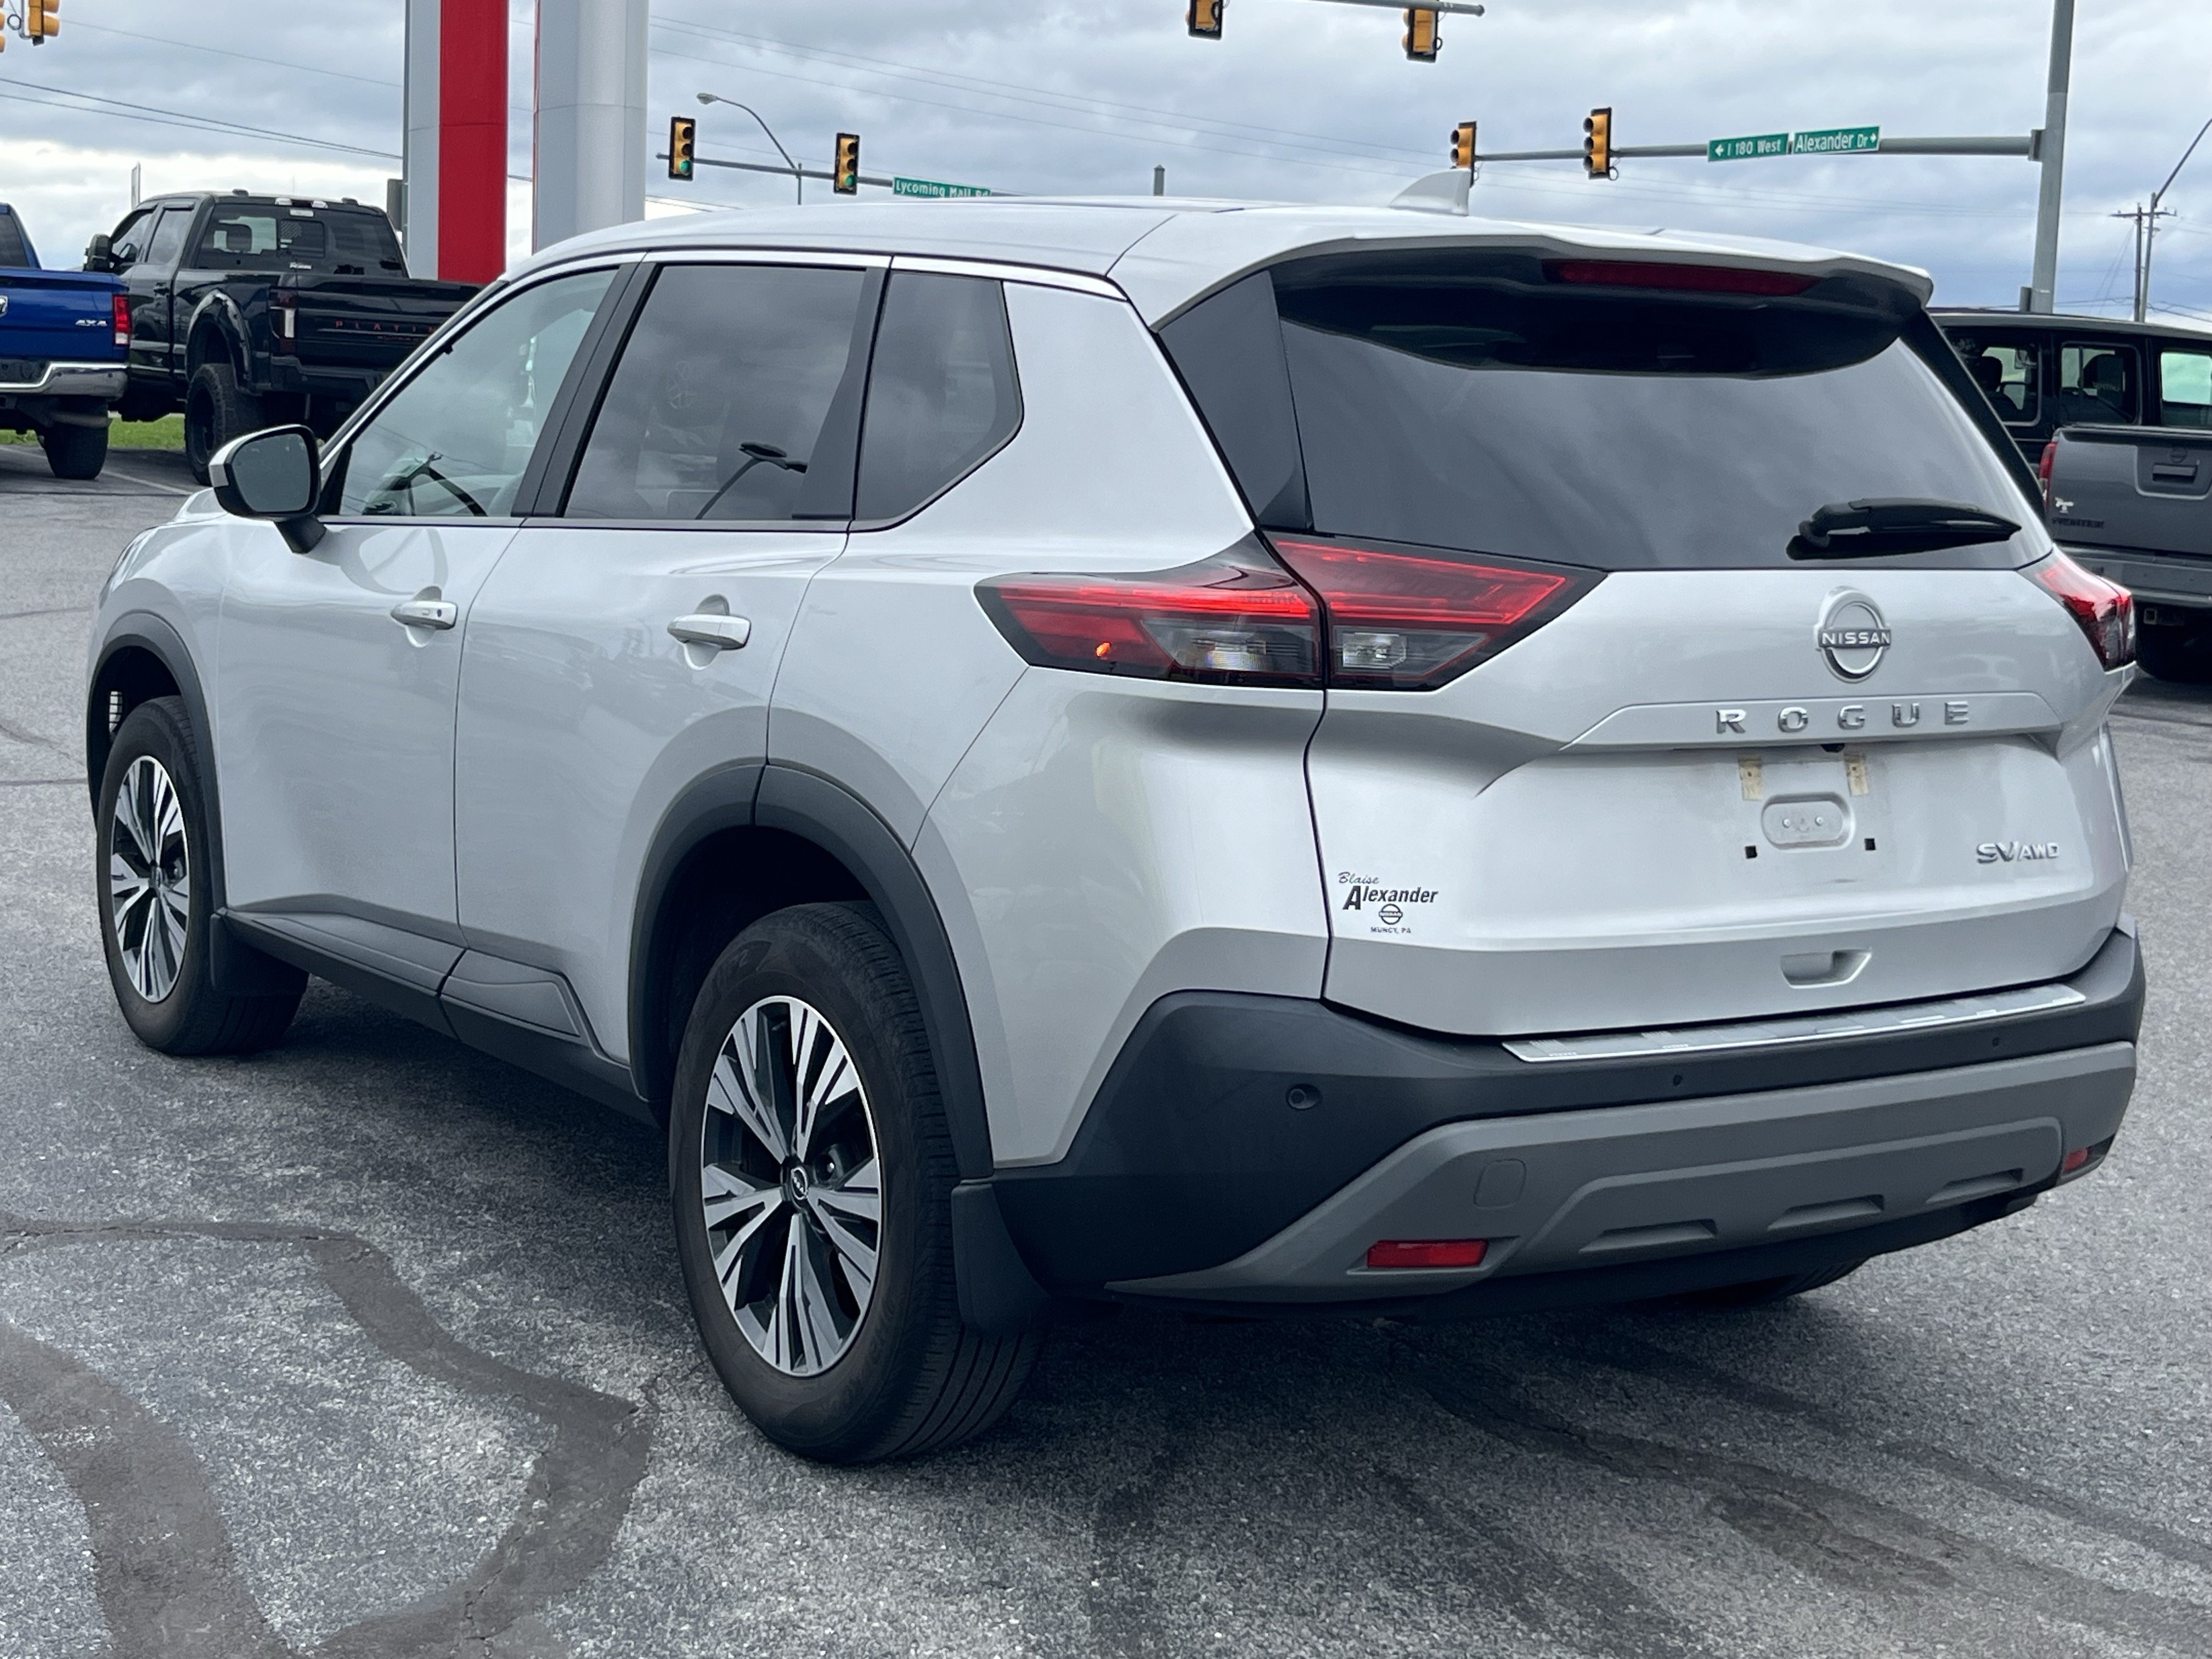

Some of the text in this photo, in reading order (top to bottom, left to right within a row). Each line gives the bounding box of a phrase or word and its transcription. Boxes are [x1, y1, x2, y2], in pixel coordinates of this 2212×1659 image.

[1736, 140, 1753, 155] 180
[1758, 139, 1781, 153] West
[1795, 131, 1867, 151] Alexander Dr
[896, 179, 945, 198] Lycoming
[949, 187, 971, 198] Mall
[1821, 632, 1890, 645] NISSAN
[1716, 701, 1969, 734] ROGUE
[1338, 871, 1379, 885] Blaise
[1342, 885, 1438, 910] Alexander
